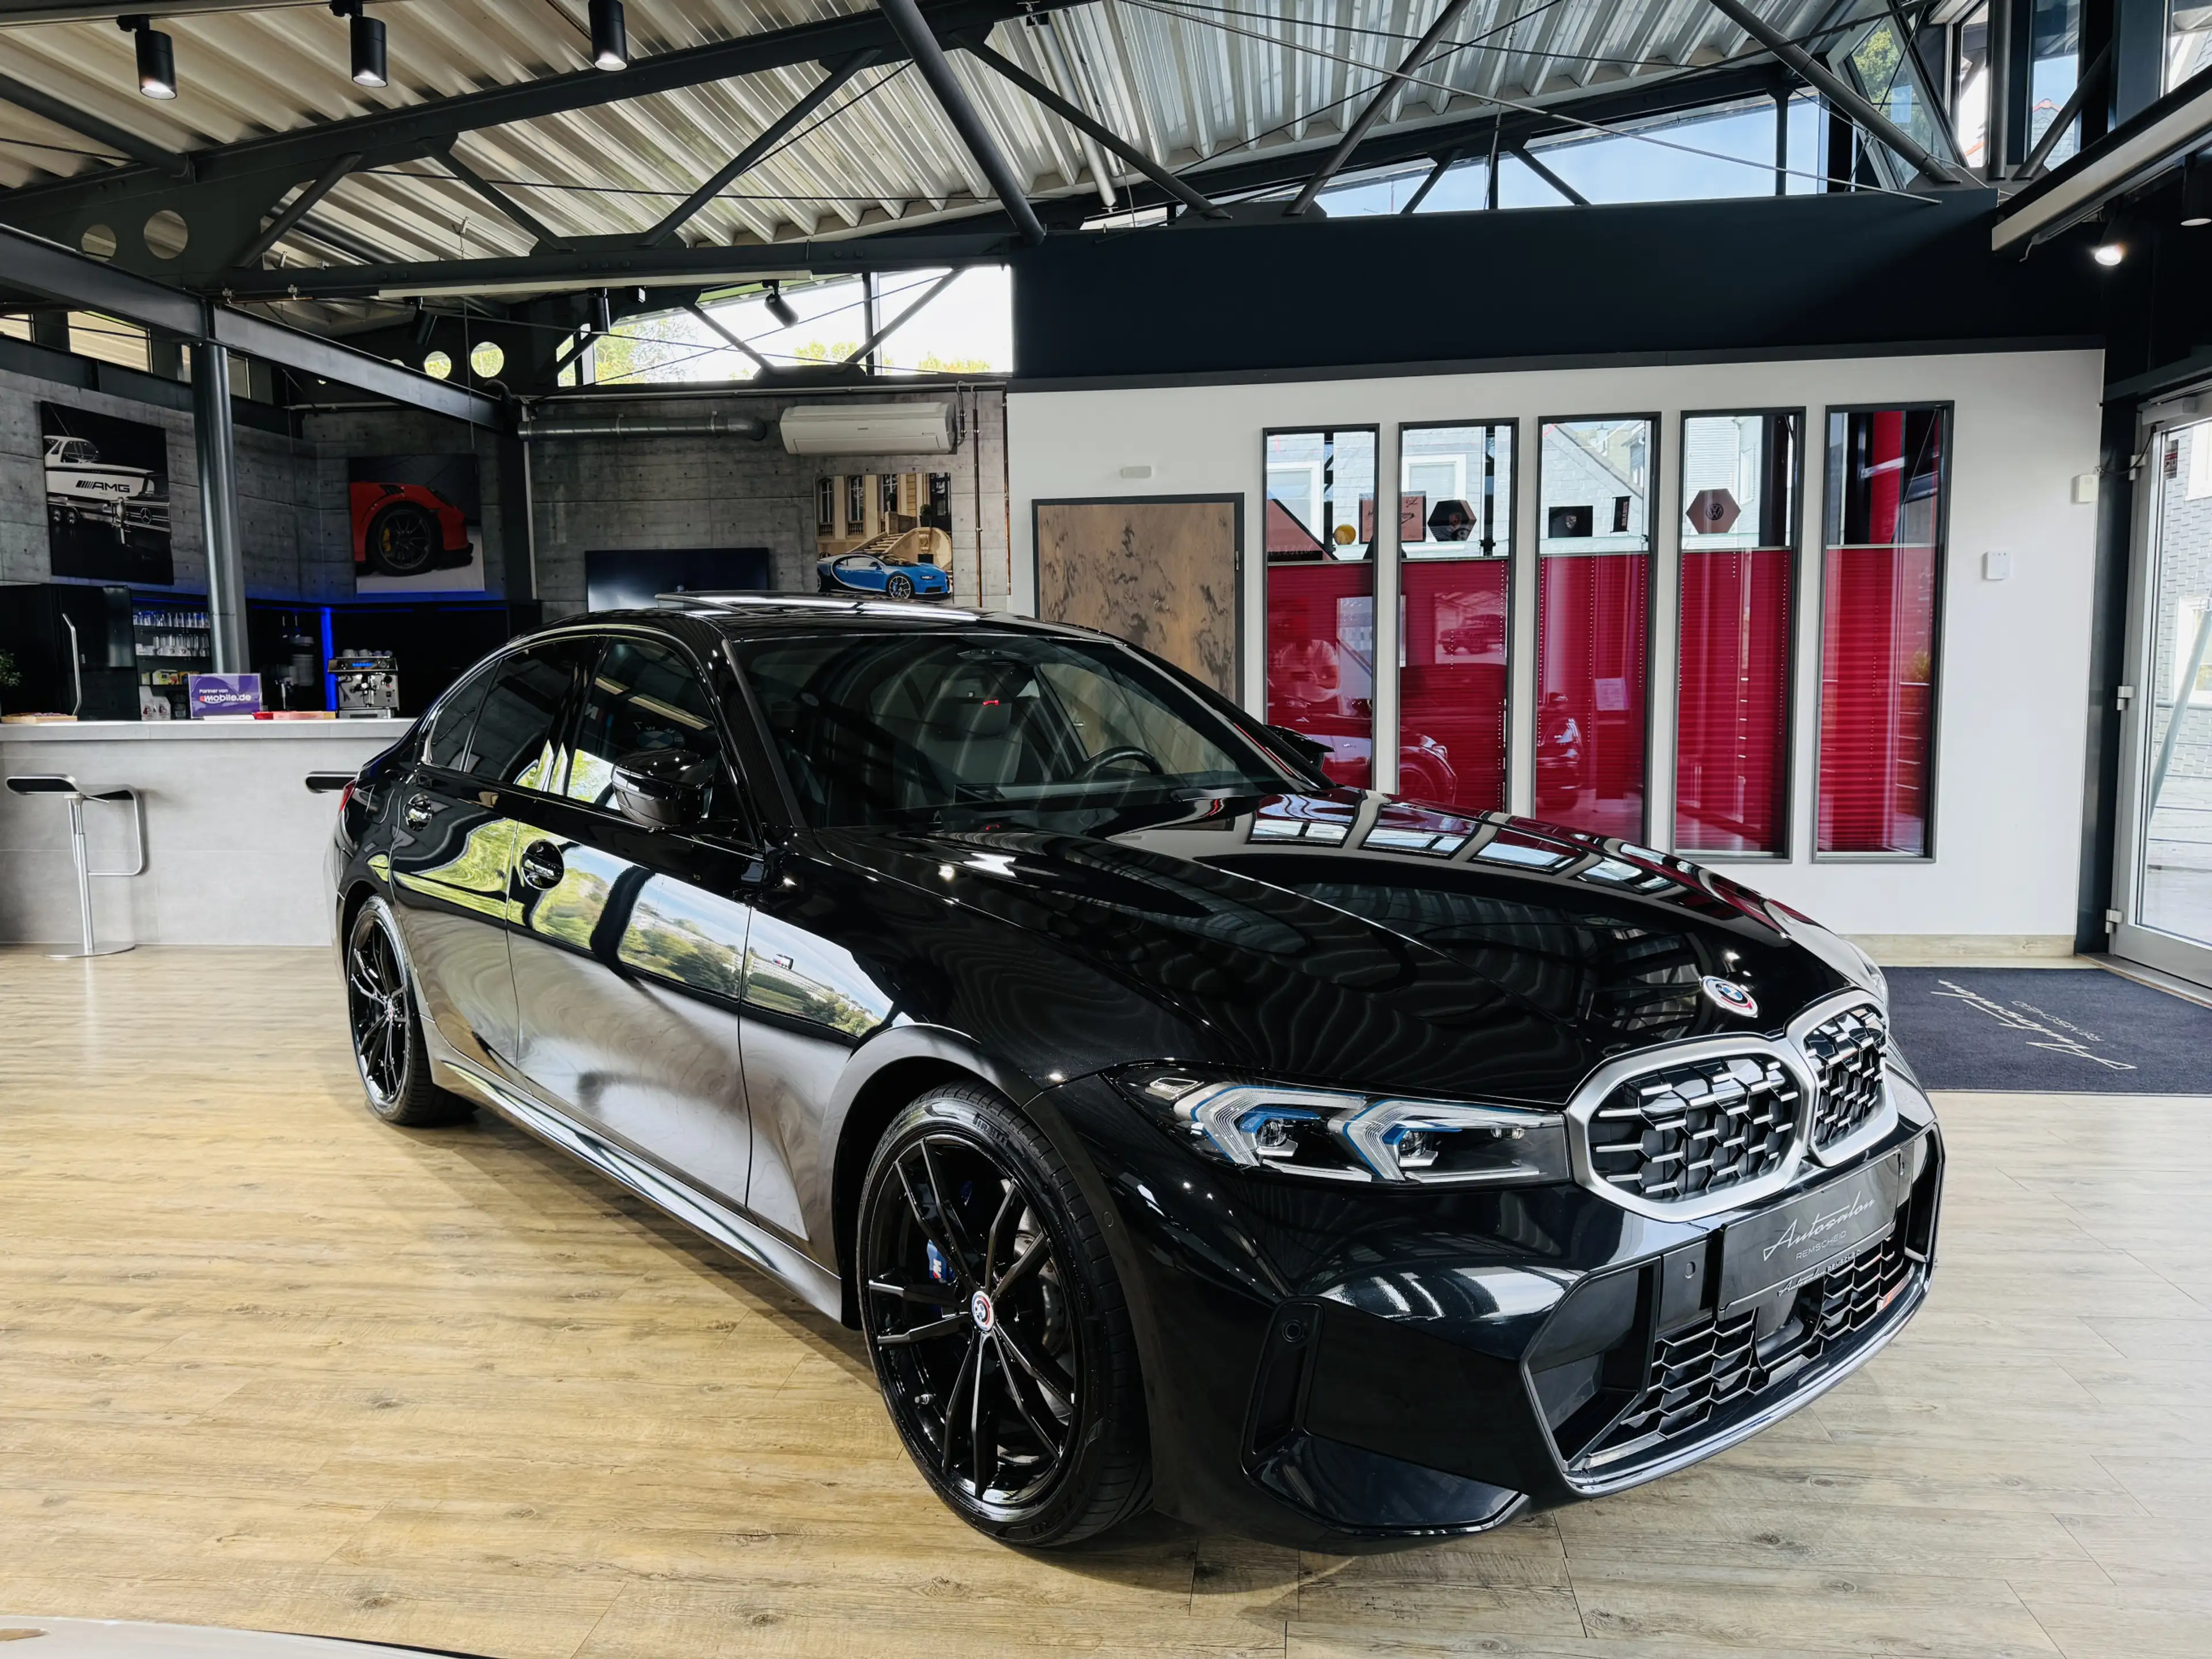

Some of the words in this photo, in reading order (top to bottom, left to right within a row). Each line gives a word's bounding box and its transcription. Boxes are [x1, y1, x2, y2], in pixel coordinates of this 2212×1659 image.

[92, 481, 130, 493] AMG
[203, 694, 252, 702] mobile.de
[1763, 1191, 1876, 1262] Autosalon
[1796, 1231, 1847, 1260] REMSCHEID
[1777, 1267, 1827, 1297] Autosalon
[1826, 1249, 1861, 1272] REMSCHEID
